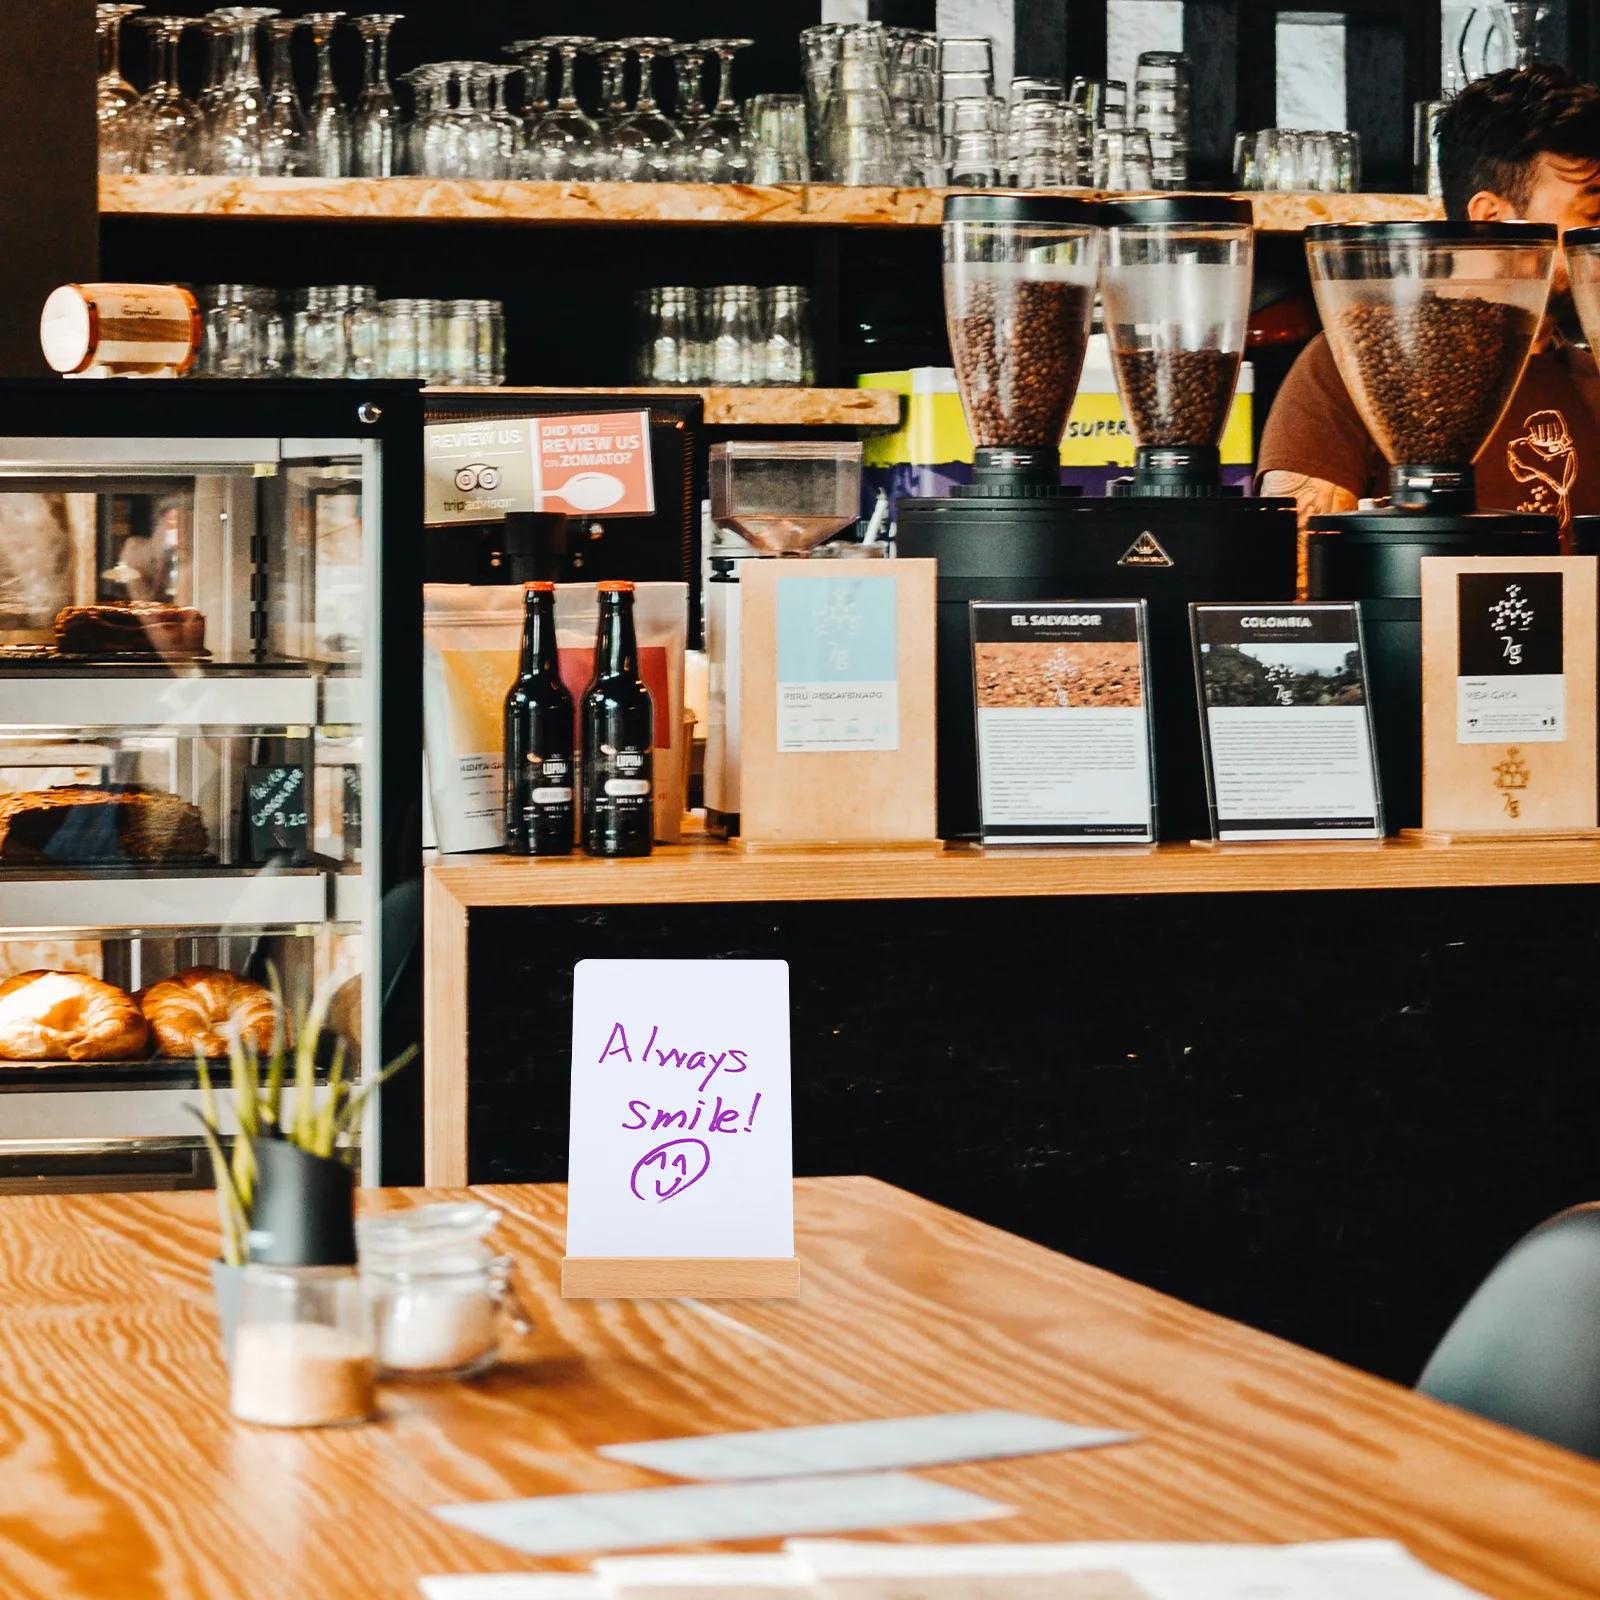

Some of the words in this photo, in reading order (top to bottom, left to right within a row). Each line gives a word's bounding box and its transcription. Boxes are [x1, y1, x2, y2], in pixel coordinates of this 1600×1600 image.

[541, 425, 568, 437] DID
[569, 423, 600, 435] YOU
[1068, 420, 1131, 438] SUPER
[430, 431, 493, 449] REVIEW
[498, 429, 523, 444] US
[542, 436, 613, 453] REVIEW
[615, 435, 640, 450] US
[559, 452, 633, 467] ZOMATO?
[443, 496, 516, 513] tripadvisor
[1011, 614, 1029, 626] EL
[1030, 614, 1102, 626] SALVADOR
[1240, 616, 1313, 628] COLOMBIA
[1500, 636, 1523, 665] 7g
[597, 1021, 749, 1093] Always
